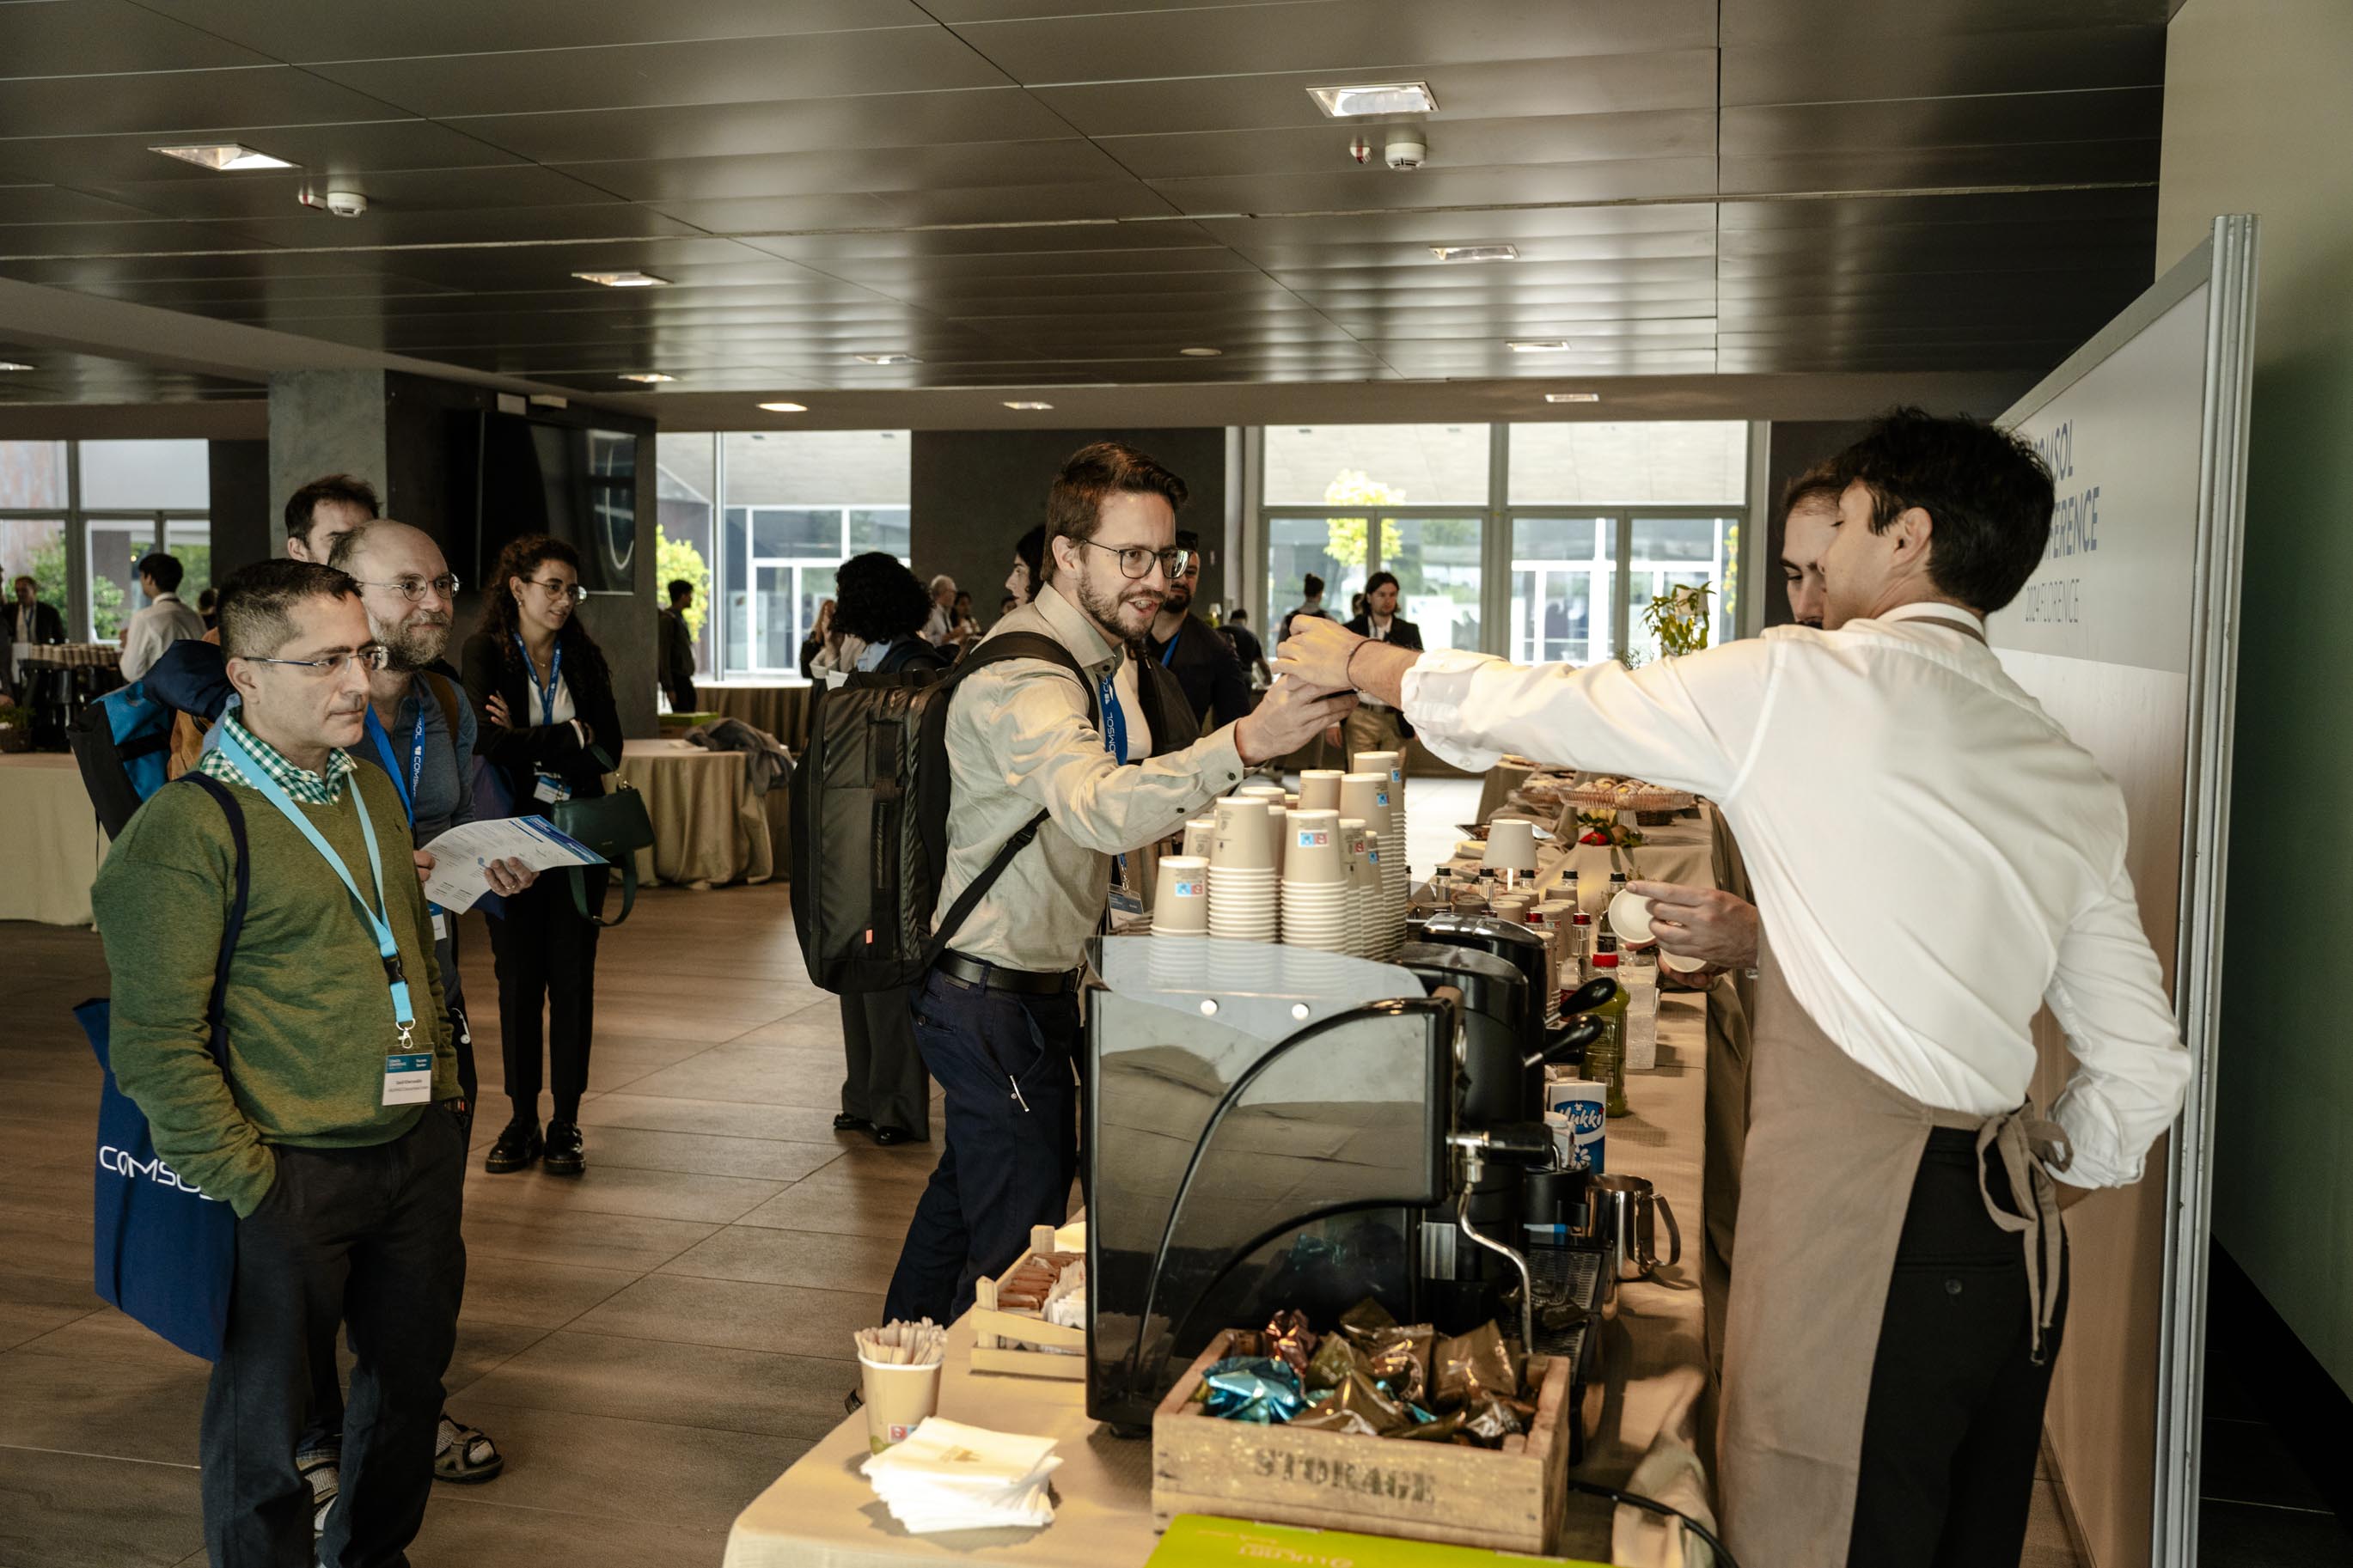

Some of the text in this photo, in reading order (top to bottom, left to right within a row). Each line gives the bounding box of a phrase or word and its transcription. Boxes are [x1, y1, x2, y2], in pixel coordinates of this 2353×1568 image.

[2040, 578, 2080, 623] FLORENCE
[1107, 711, 1116, 756] OMSOL
[99, 1145, 214, 1200] COMSO
[1255, 1449, 1438, 1503] STORAGE
